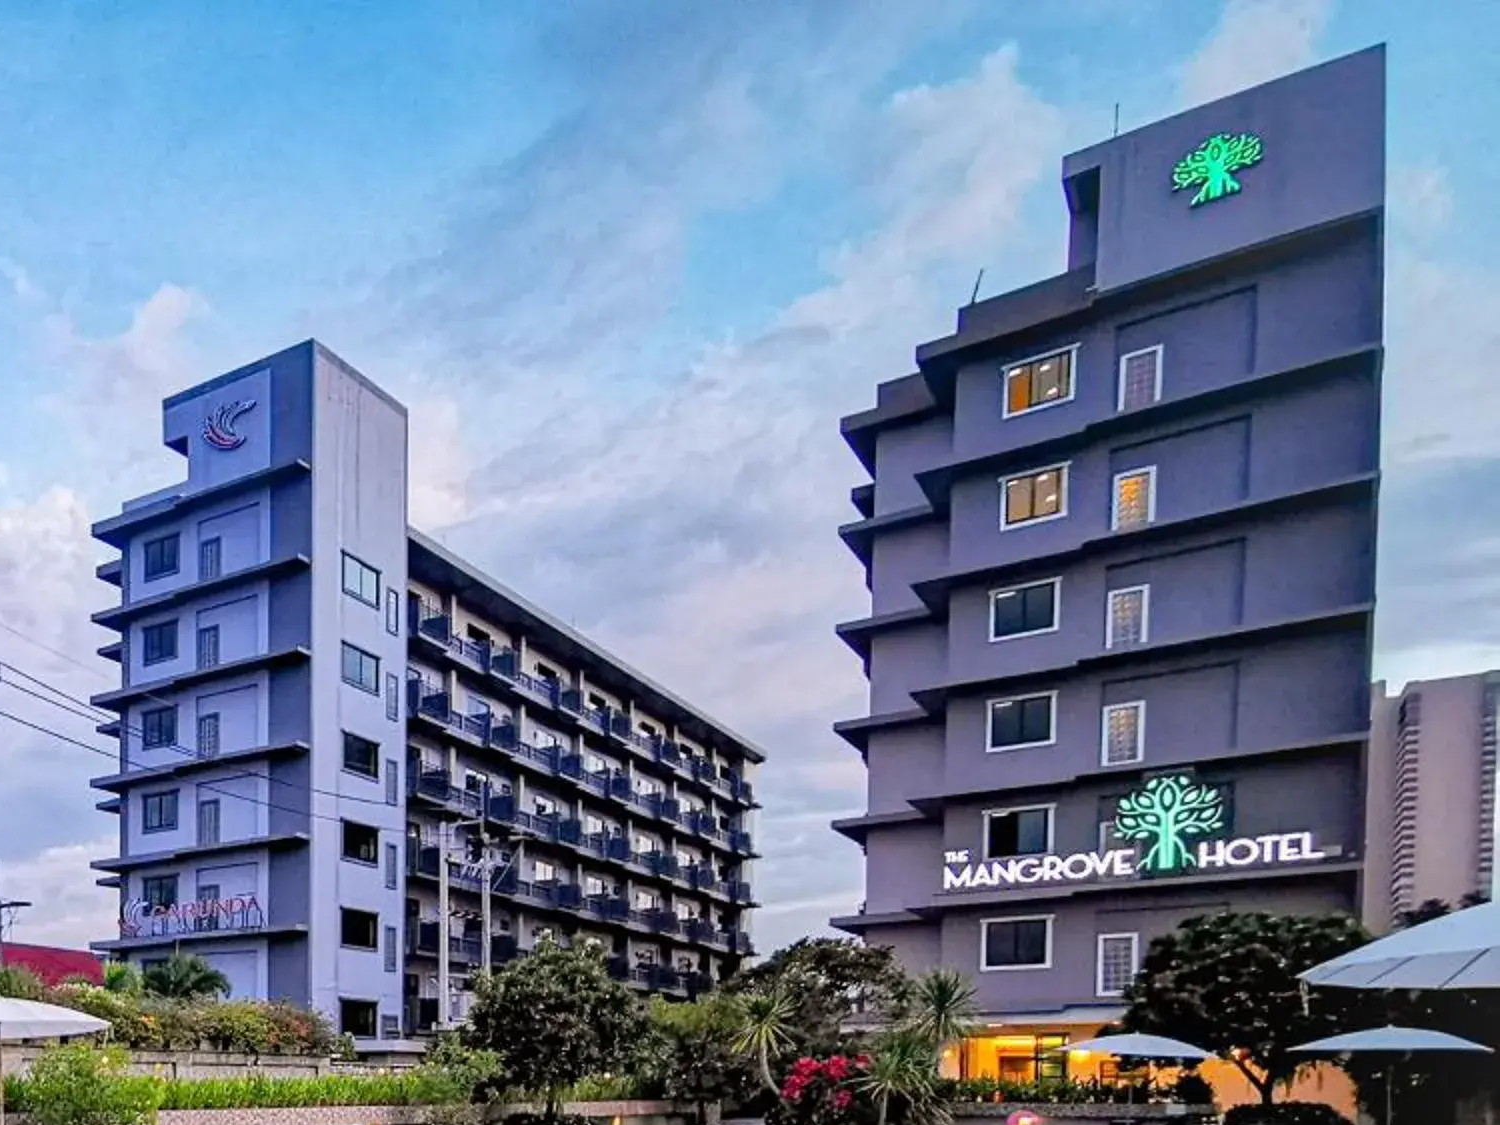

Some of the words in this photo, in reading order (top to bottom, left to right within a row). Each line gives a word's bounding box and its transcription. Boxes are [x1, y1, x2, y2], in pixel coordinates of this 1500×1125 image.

[943, 849, 1135, 889] MANGROVE
[1198, 832, 1326, 868] HOTEL
[944, 850, 968, 863] THE
